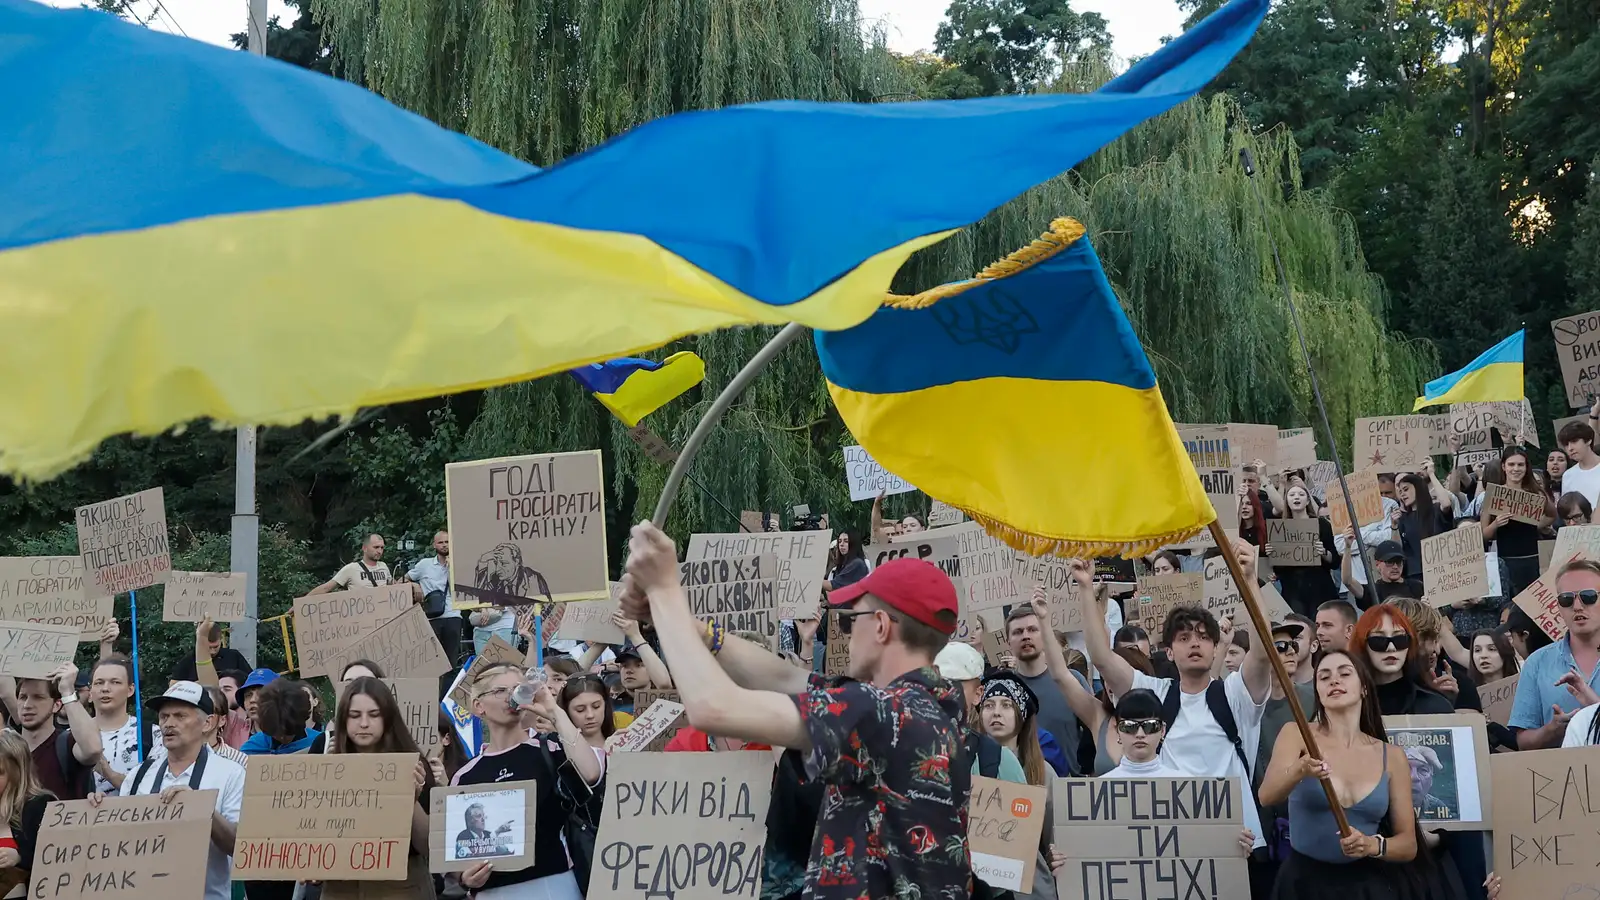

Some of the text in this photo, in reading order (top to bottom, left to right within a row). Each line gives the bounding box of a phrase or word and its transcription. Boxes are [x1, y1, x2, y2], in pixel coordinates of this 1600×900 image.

[1369, 418, 1429, 433] СИРСЬКОГО
[1369, 432, 1409, 446] ГЕТЬ!
[1464, 452, 1497, 464] 1984?
[489, 457, 555, 498] ГОДІ
[80, 502, 120, 527] ЯКЩО
[496, 492, 601, 520] ПРОСИРАТИ
[1491, 500, 1505, 512] НЕ
[82, 521, 163, 551] БЕЗ СИРСЬКОГО
[93, 525, 103, 538] НЕ
[508, 516, 588, 541] КРАЇНУ!
[83, 535, 169, 571] ПІДЕТЕ РАЗОМ
[703, 535, 816, 559] МІНЯЙТЕ НЕ
[1423, 526, 1483, 564] СИРСЬКОГО
[95, 554, 170, 586] ЗМІНИМОСЯ АБО
[360, 571, 386, 581] PMA
[681, 559, 729, 586] ЯКОГО
[1043, 566, 1073, 595] ЛОХ
[1438, 572, 1463, 584] АРМІЯ
[13, 598, 98, 618] АРМІЙСЬКУ
[301, 594, 376, 627] ФЕДОРОВ
[389, 590, 409, 611] МО
[686, 581, 774, 614] ІЙСЬКОВИМ
[27, 615, 106, 633] ФОРМУ
[301, 621, 360, 646] СИРСЬКИЙ
[24, 631, 71, 654] ЯКЕ
[616, 777, 756, 822] РУКИ ВІД
[1067, 777, 1232, 821] СИРСЬКИЙ
[50, 801, 185, 828] ЗЕЛЕНСЬКИЙ
[42, 834, 167, 865] СИРСЬКИЙ
[237, 837, 399, 871] ЗМІНЮЄМО СВІТ
[1128, 825, 1180, 858] ТИ
[1511, 833, 1575, 870] ВЖЕ
[601, 841, 762, 900] ФЕДОРОВА
[1081, 858, 1218, 900] ПЕТУХ!
[35, 870, 136, 900] ЄРМАК
